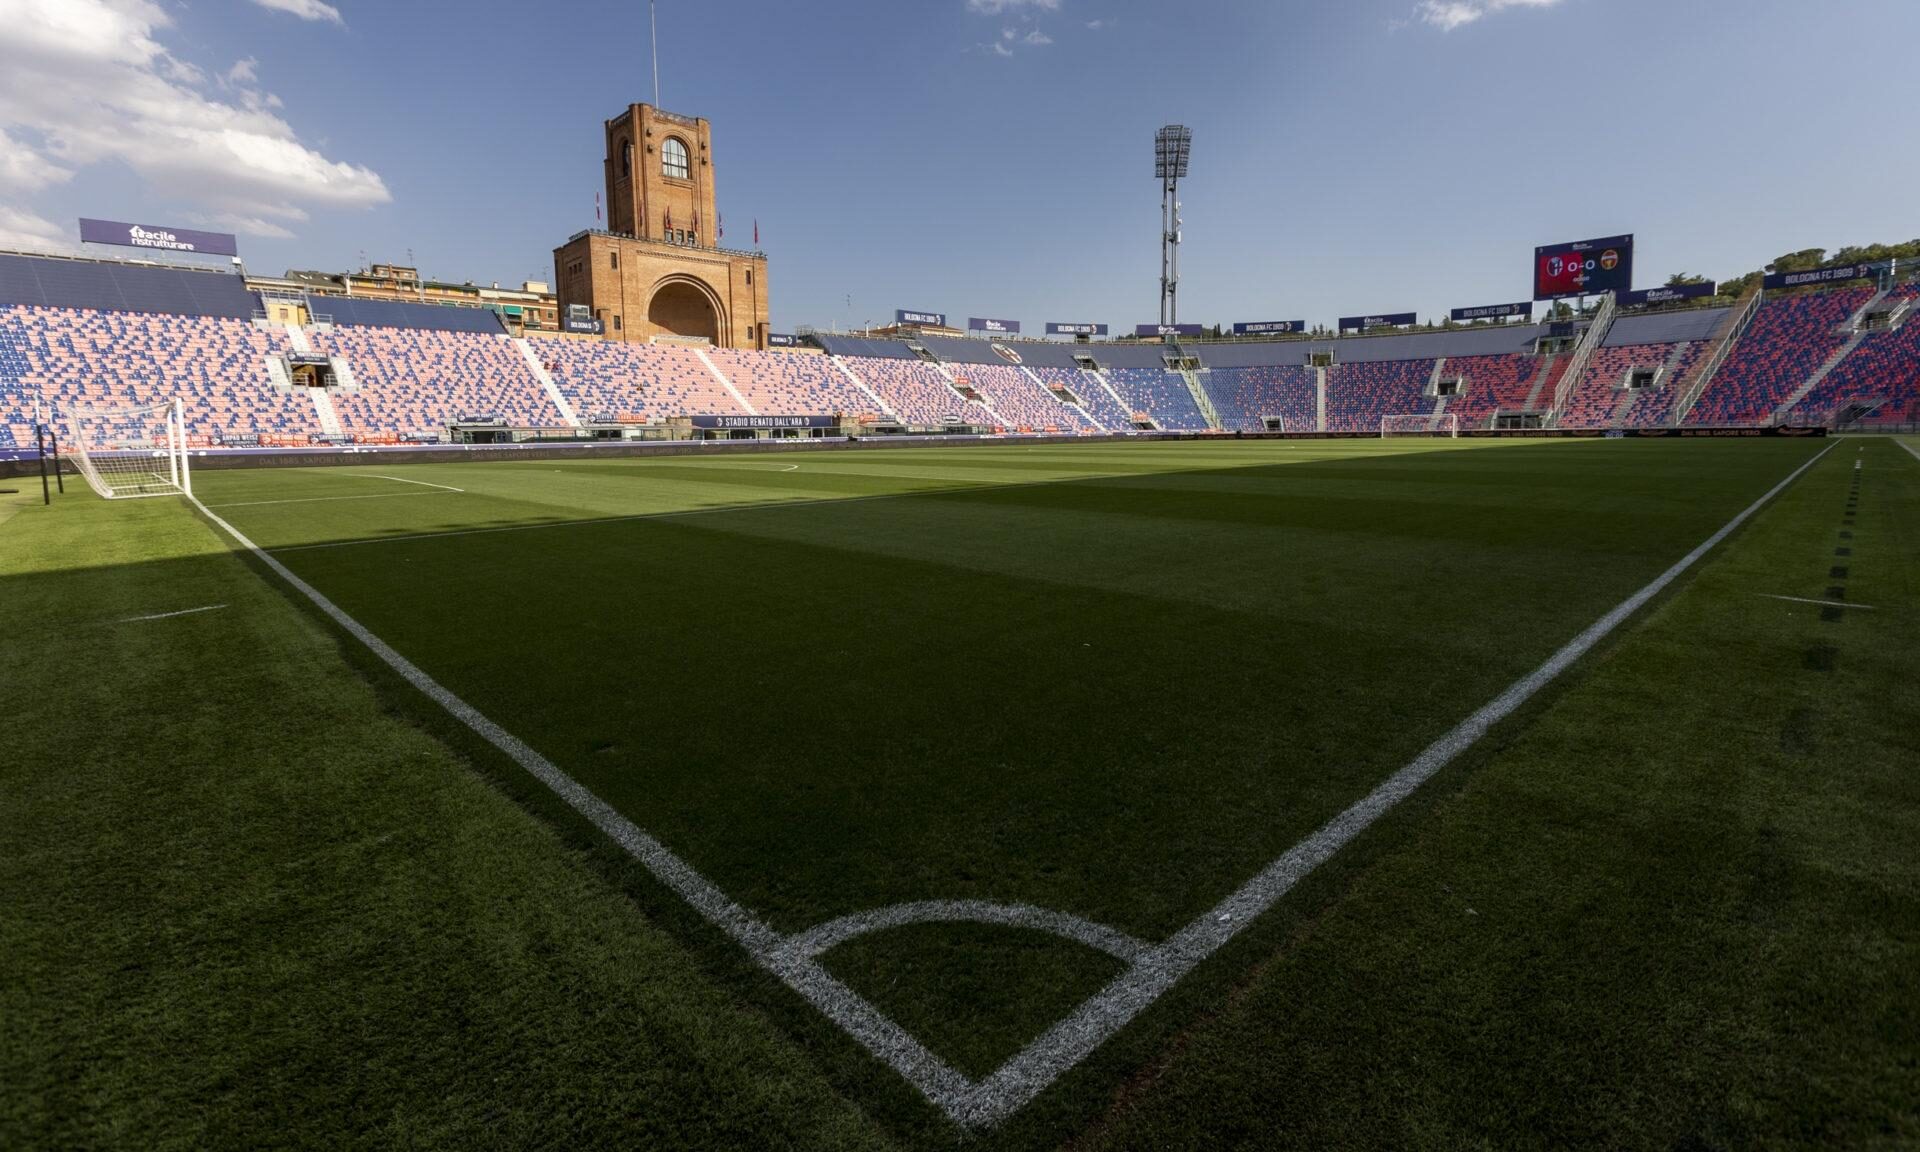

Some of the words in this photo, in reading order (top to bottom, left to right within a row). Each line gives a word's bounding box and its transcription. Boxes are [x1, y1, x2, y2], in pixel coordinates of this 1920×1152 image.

[131, 238, 194, 250] ristrutturare
[1785, 273, 1820, 284] BOLOGNA
[1821, 270, 1832, 280] FC
[1833, 268, 1854, 279] 1909
[1463, 309, 1488, 317] BOLOGNA
[1246, 324, 1266, 332] BOLOGNA
[725, 417, 748, 426] STADIO
[750, 417, 773, 426] RENATO
[774, 417, 803, 426] DALL'ARA
